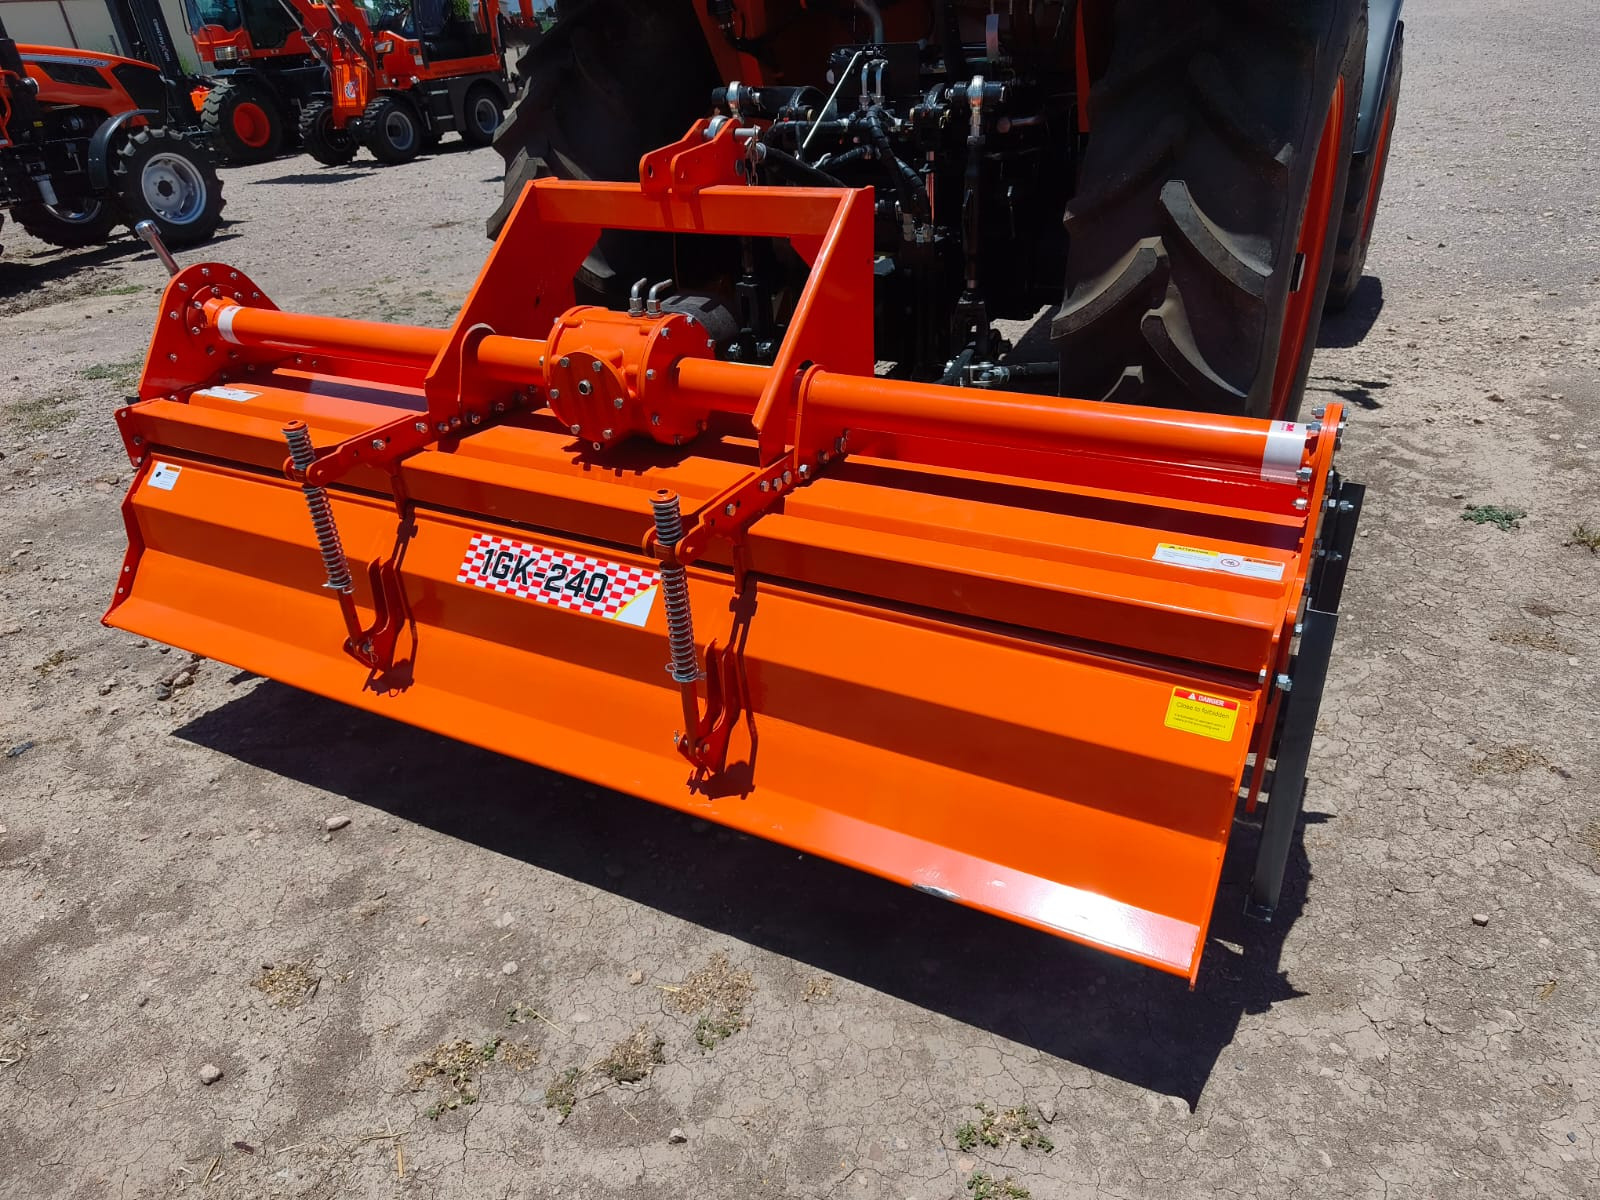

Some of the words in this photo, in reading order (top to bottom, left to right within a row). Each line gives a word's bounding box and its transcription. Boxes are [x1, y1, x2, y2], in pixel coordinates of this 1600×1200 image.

[481, 549, 608, 602] 1GK-240
[1176, 701, 1194, 711] Close
[1198, 695, 1225, 707] DANGER
